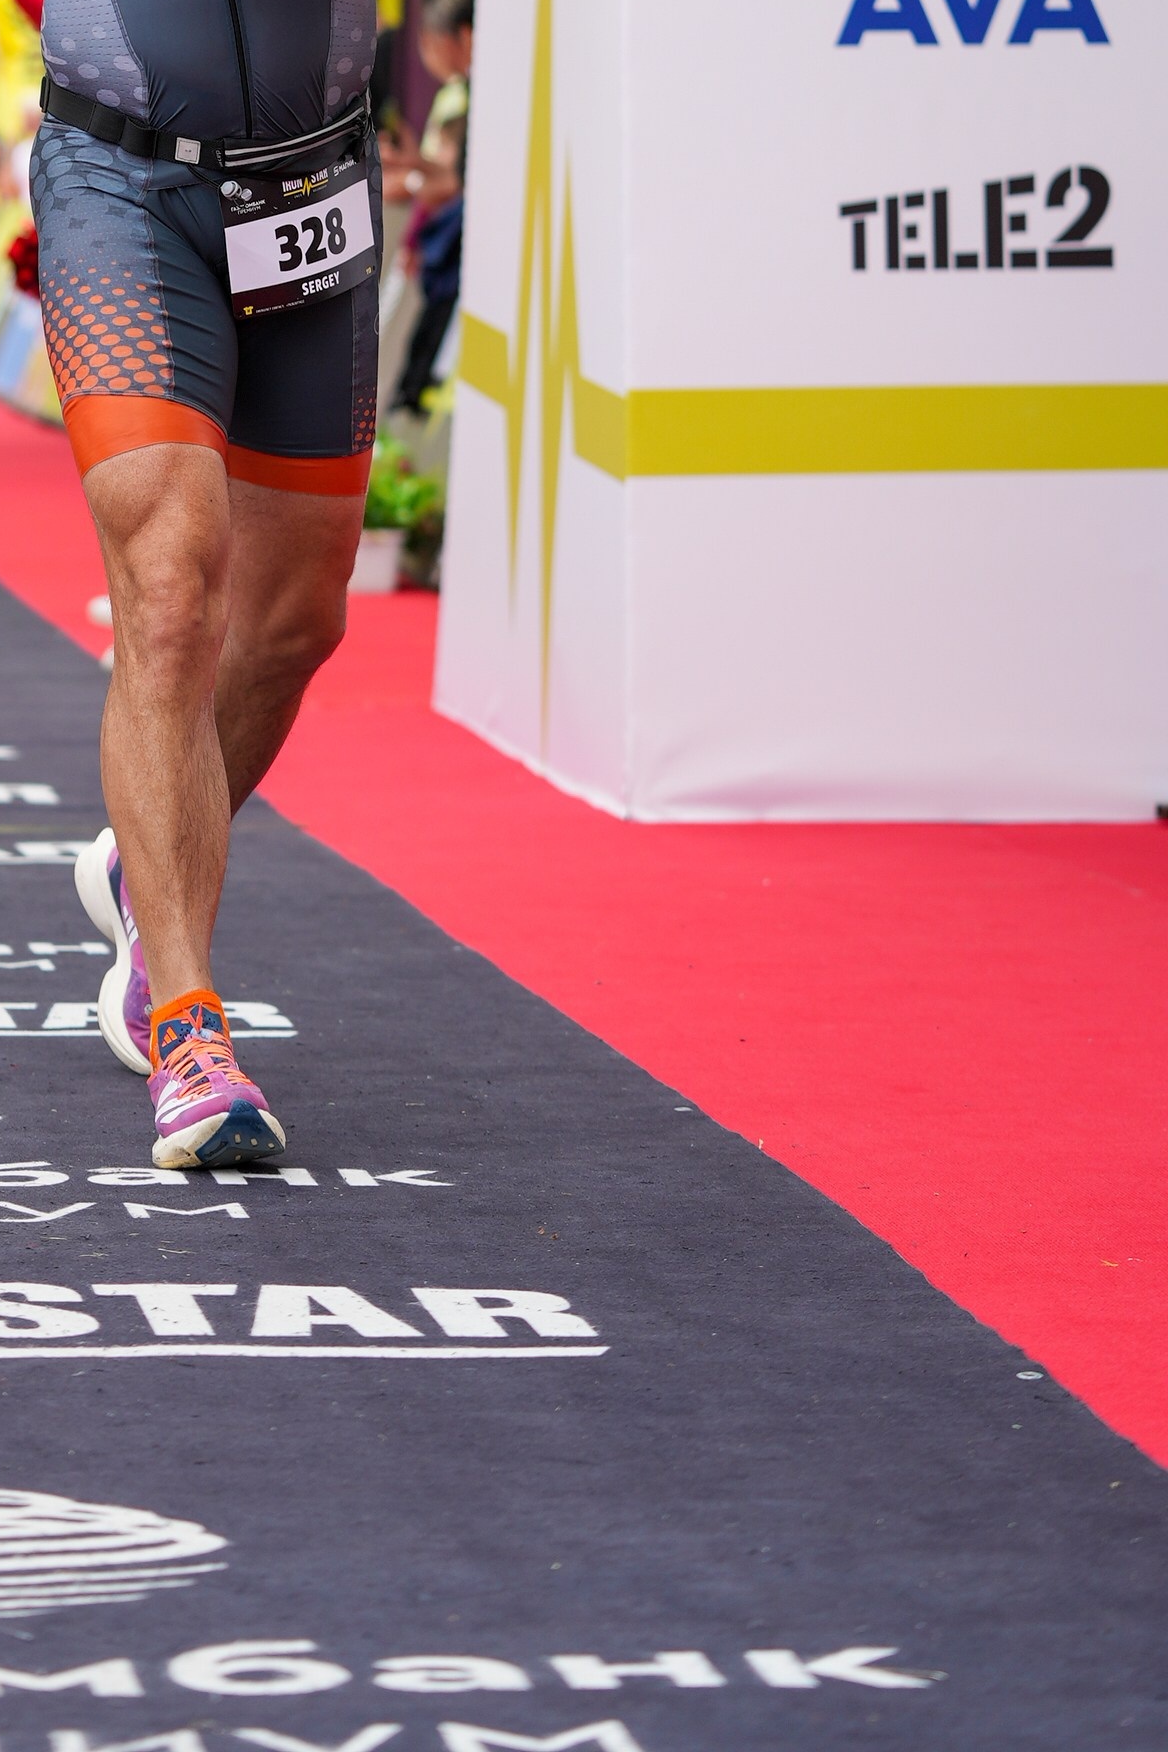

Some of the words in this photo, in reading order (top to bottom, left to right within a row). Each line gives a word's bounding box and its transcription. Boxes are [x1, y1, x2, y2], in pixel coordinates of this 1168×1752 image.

[274, 207, 347, 273] 328
[838, 165, 1115, 272] TELE2
[301, 270, 341, 297] SERGEY
